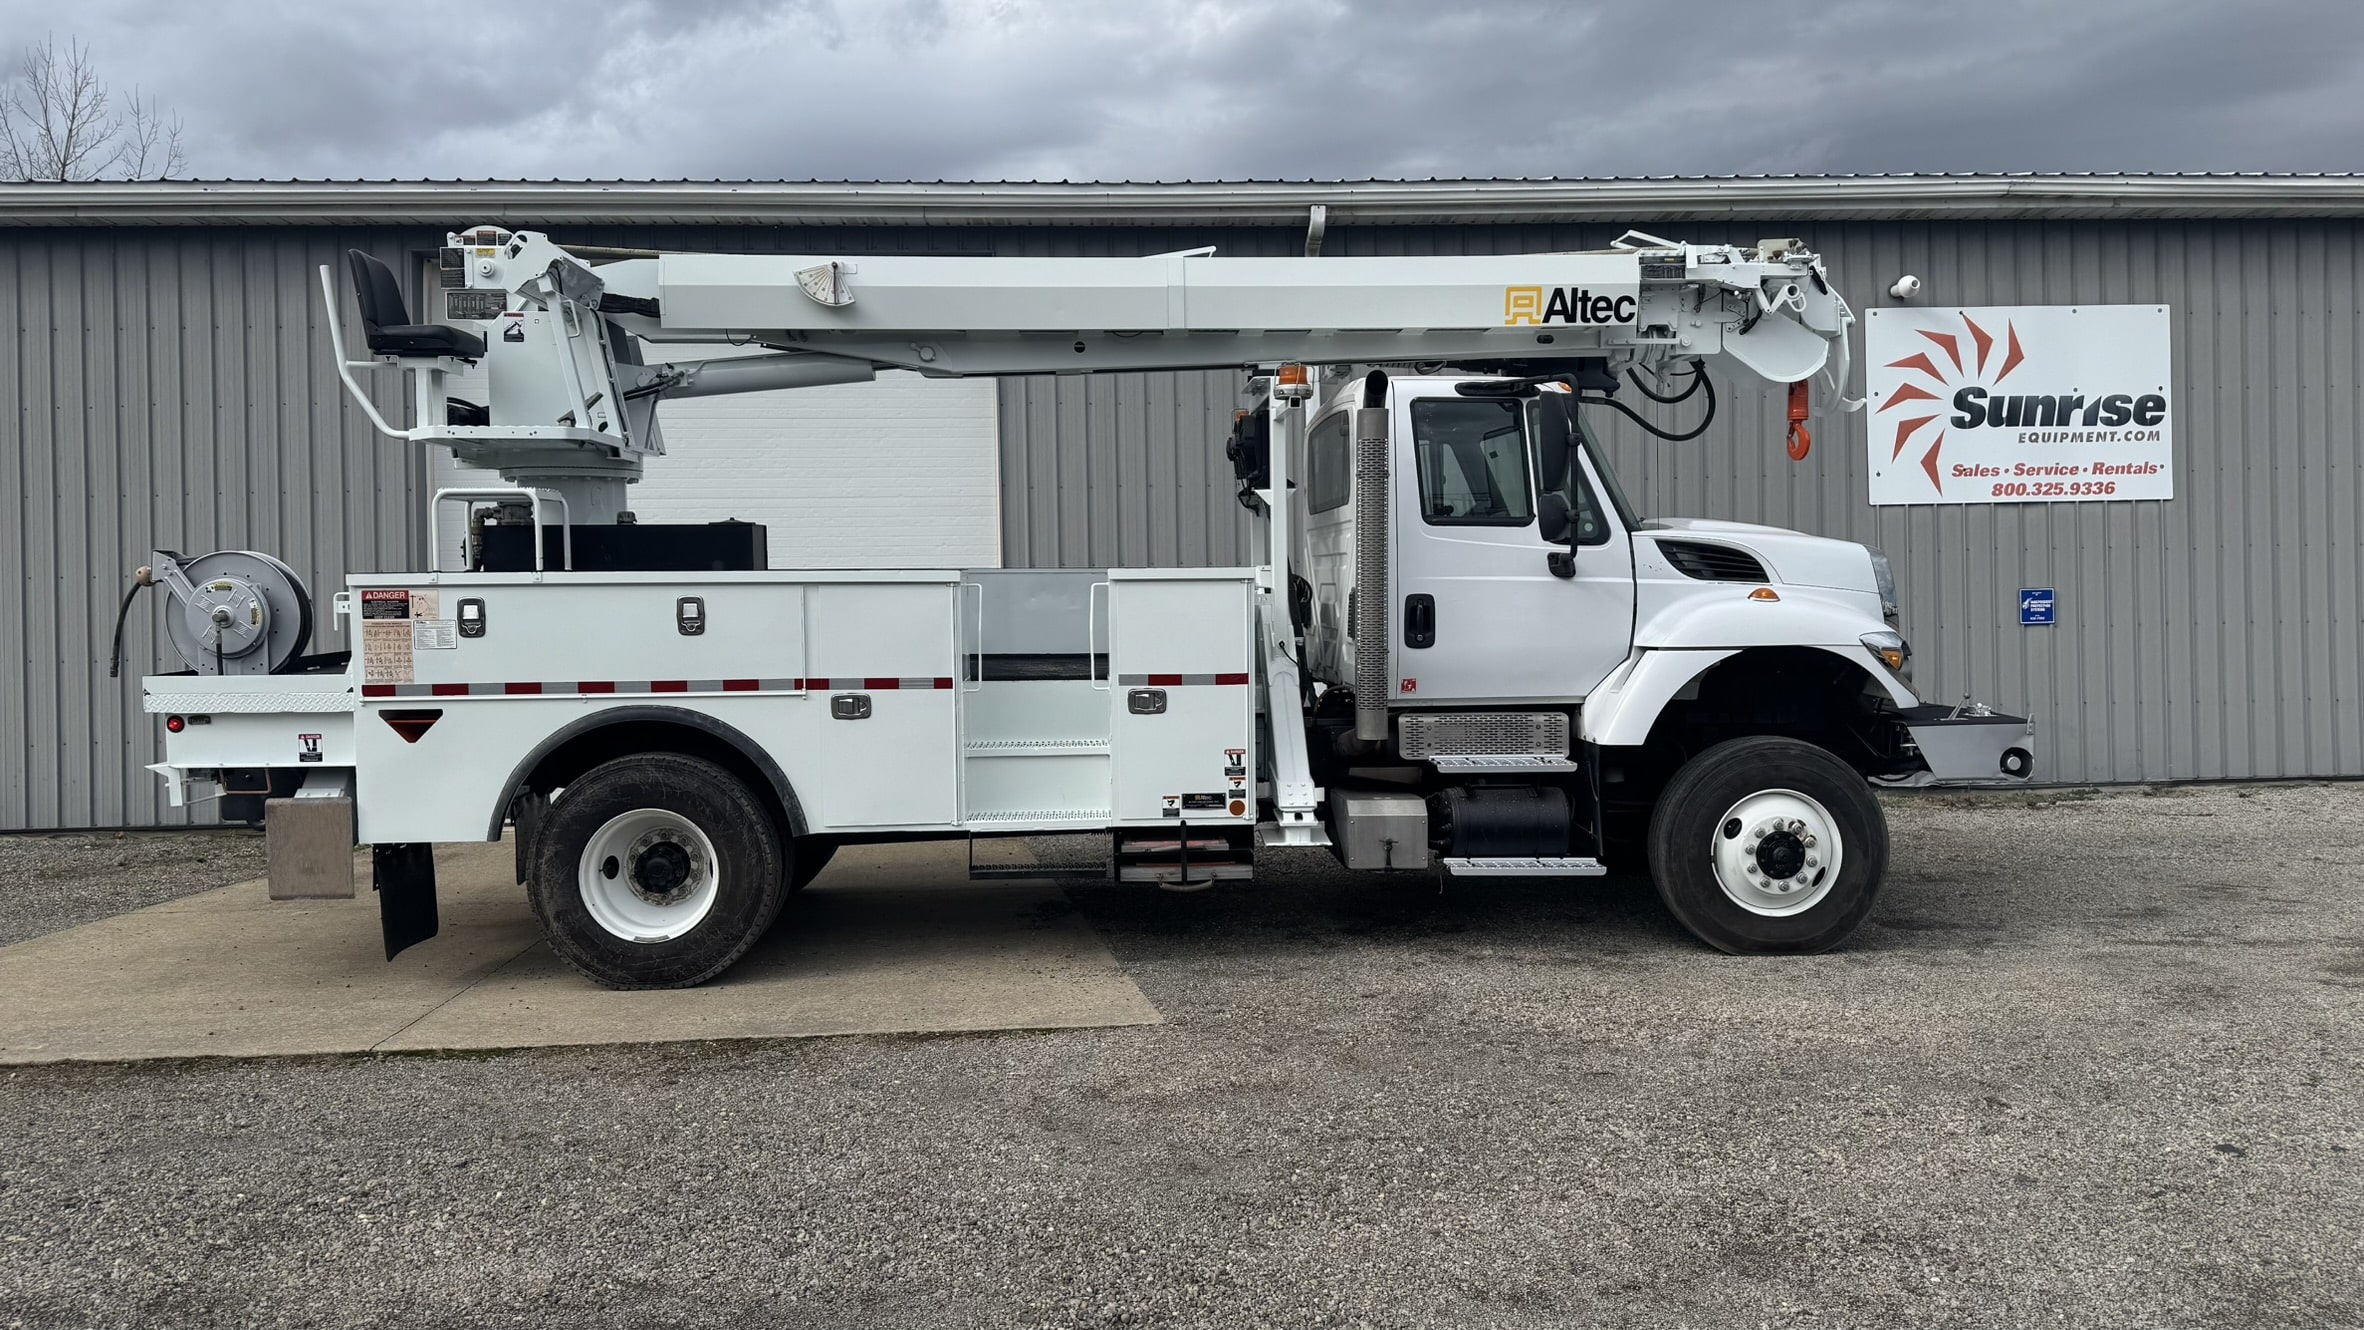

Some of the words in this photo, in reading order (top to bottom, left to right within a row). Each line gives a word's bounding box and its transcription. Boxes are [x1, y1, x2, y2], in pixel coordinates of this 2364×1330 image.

[1542, 287, 1636, 323] Altec
[1950, 386, 2166, 429] Sunrise
[2018, 430, 2160, 443] EQUIPMENT.COM
[1952, 463, 2000, 477] Sales
[2013, 462, 2079, 476] Service
[2092, 461, 2158, 475] Rentals
[1991, 481, 2116, 496] 800.325.9336
[373, 591, 405, 599] DANGER
